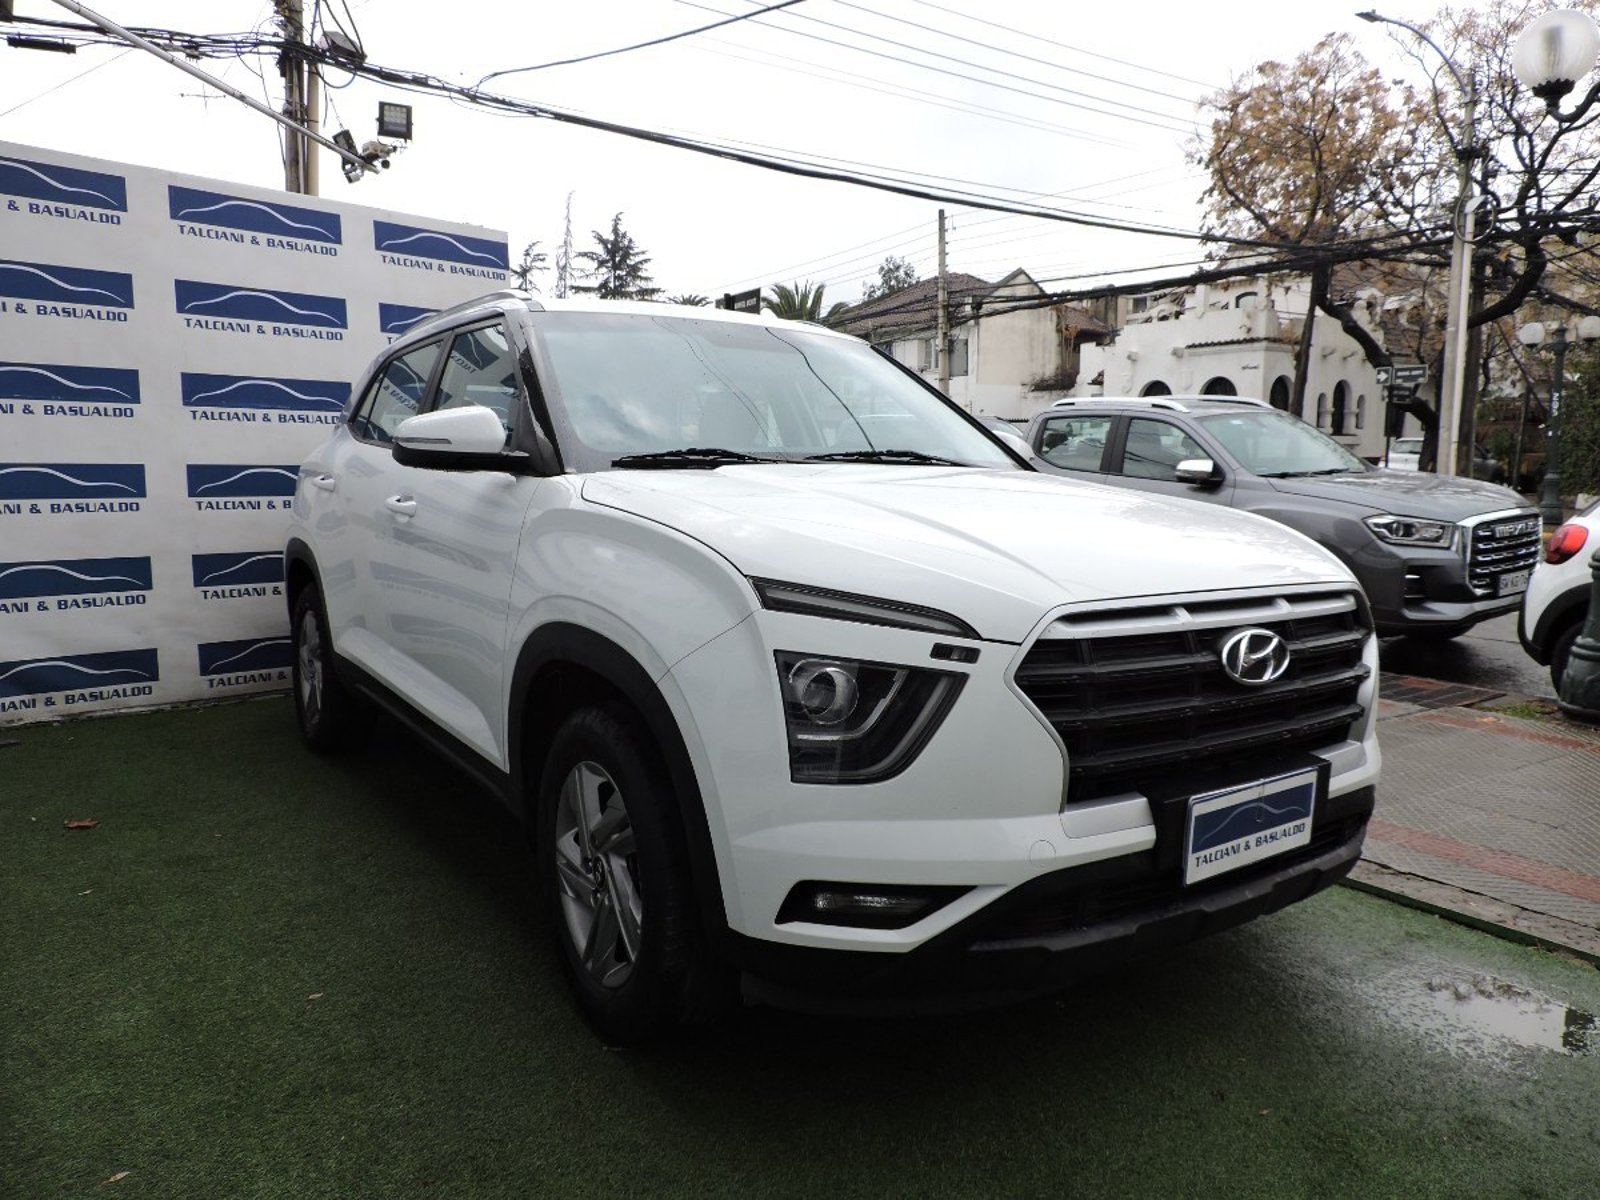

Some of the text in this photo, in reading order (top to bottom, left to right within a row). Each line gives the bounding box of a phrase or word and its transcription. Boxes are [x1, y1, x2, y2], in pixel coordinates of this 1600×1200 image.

[7, 199, 120, 225] & BASUALDO
[177, 224, 337, 257] TALCIANI & BASUALDO
[381, 254, 506, 281] TALCIANI & BASUALDO
[15, 303, 27, 314] &
[36, 304, 128, 322] BASUALDO
[184, 318, 343, 341] TALCIANI & BASUALDO
[22, 404, 35, 415] &
[43, 404, 134, 418] BASUALDO
[189, 410, 339, 425] TALCIANI & BASUALD
[29, 503, 42, 514] &
[50, 502, 140, 514] BASUALDO
[195, 500, 261, 511] TALCIANI
[266, 500, 276, 510] &
[201, 586, 282, 600] TALCIANI &
[36, 600, 49, 612] &
[57, 594, 146, 610] BASUALDO
[207, 671, 287, 689] TALCIANI &
[44, 696, 57, 707] &
[64, 685, 152, 705] BASUALDO
[1195, 823, 1305, 868] TALCIANI & BASUALDO
